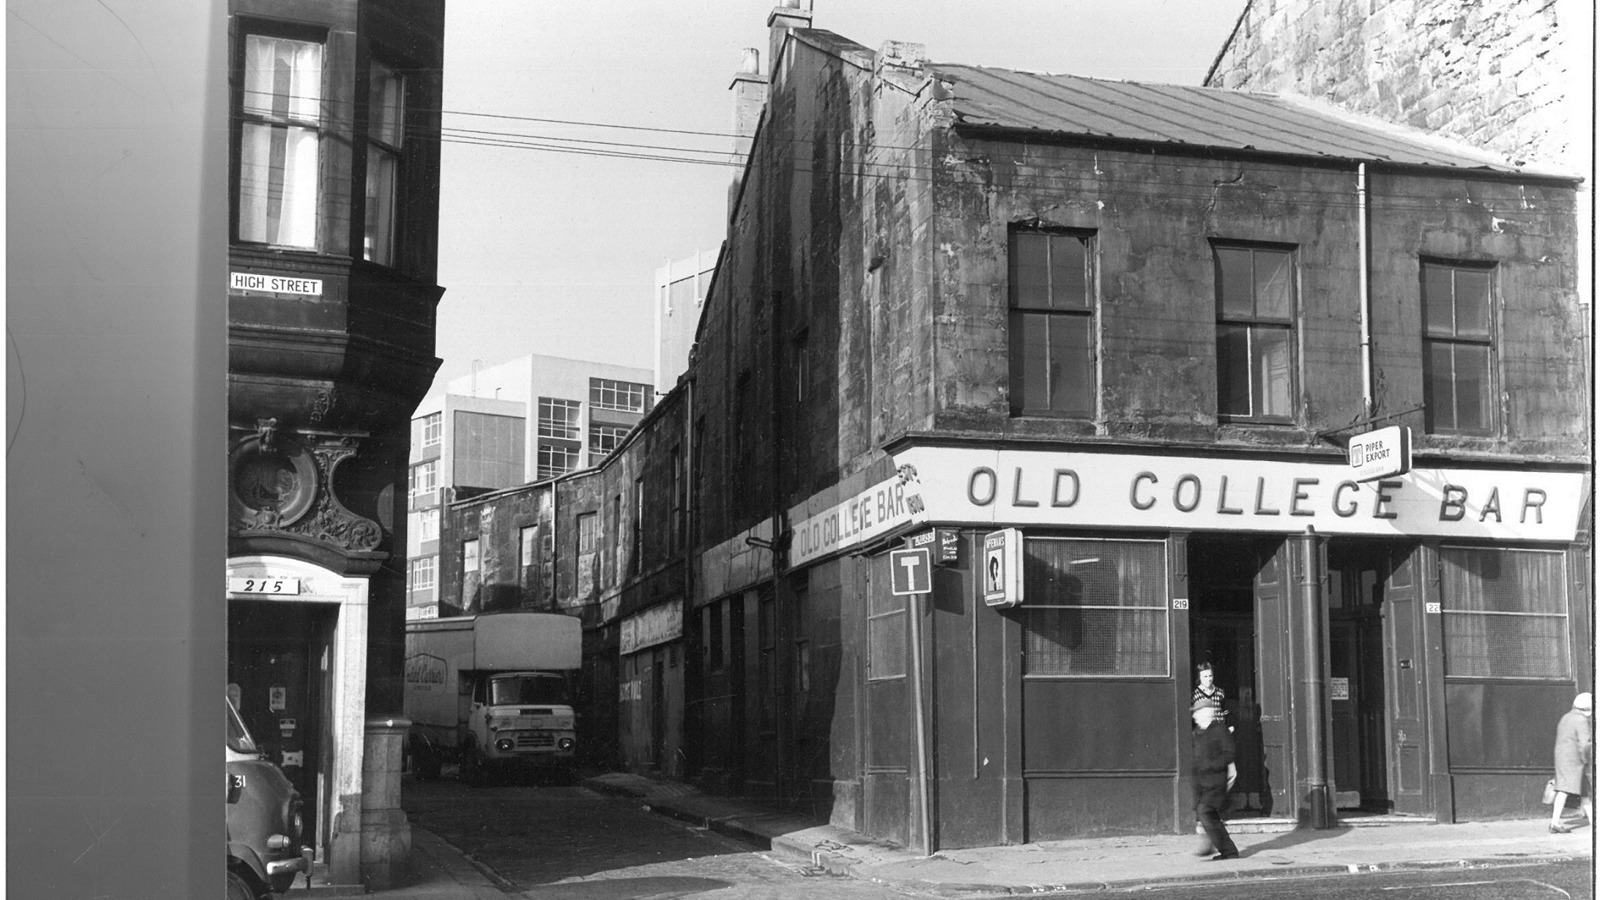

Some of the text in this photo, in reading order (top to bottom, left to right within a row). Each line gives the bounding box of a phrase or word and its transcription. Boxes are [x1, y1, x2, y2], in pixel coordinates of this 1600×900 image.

[235, 275, 318, 293] HIGH STREET
[1365, 440, 1384, 452] PIPER
[1366, 448, 1391, 462] EXPORT
[967, 465, 1081, 509] OLD
[1129, 472, 1403, 519] COLLEGE
[1438, 484, 1548, 525] BAR
[800, 522, 820, 557] OLD
[823, 495, 872, 548] COLLEGE
[877, 482, 905, 523] BAR
[244, 579, 283, 592] 215
[1174, 600, 1187, 608] 219
[234, 775, 246, 788] 31
